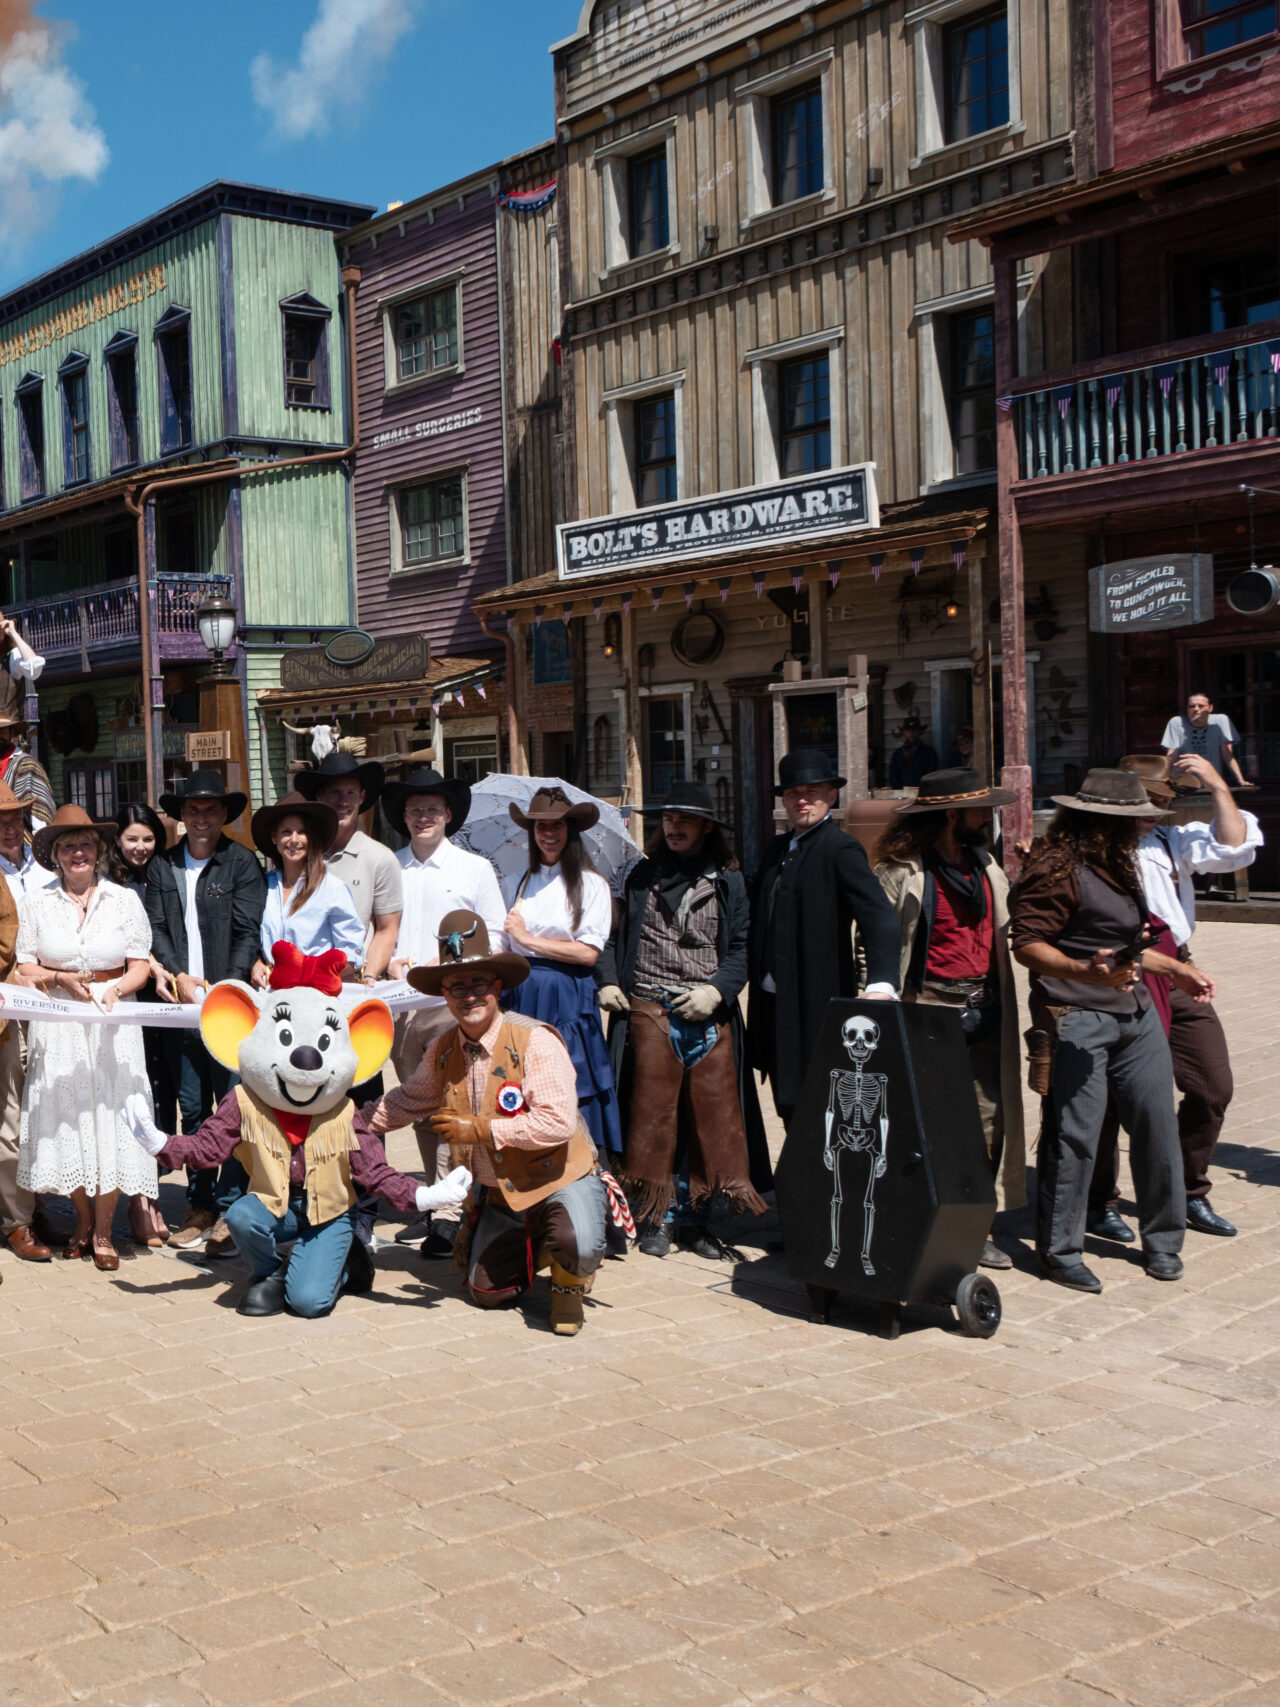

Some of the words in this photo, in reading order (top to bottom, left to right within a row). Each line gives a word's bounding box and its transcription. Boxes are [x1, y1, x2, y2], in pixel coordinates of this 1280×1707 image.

[373, 425, 411, 449] SMALL
[415, 407, 482, 437] SURGERIES
[1107, 582, 1133, 596] FROM
[1135, 566, 1175, 587] PICKLES
[1110, 600, 1121, 609] TO
[1124, 577, 1186, 607] GUNPOWDER,
[1112, 612, 1128, 622] WE
[1130, 602, 1154, 620] HOLD
[1157, 596, 1168, 608] IT
[1169, 592, 1191, 603] ALL.
[285, 658, 319, 687] GENERAL
[376, 641, 421, 677] PHYSICIAN
[191, 747, 222, 759] STREET
[197, 737, 217, 748] MAIN
[13, 999, 70, 1013] RIVERSIDE
